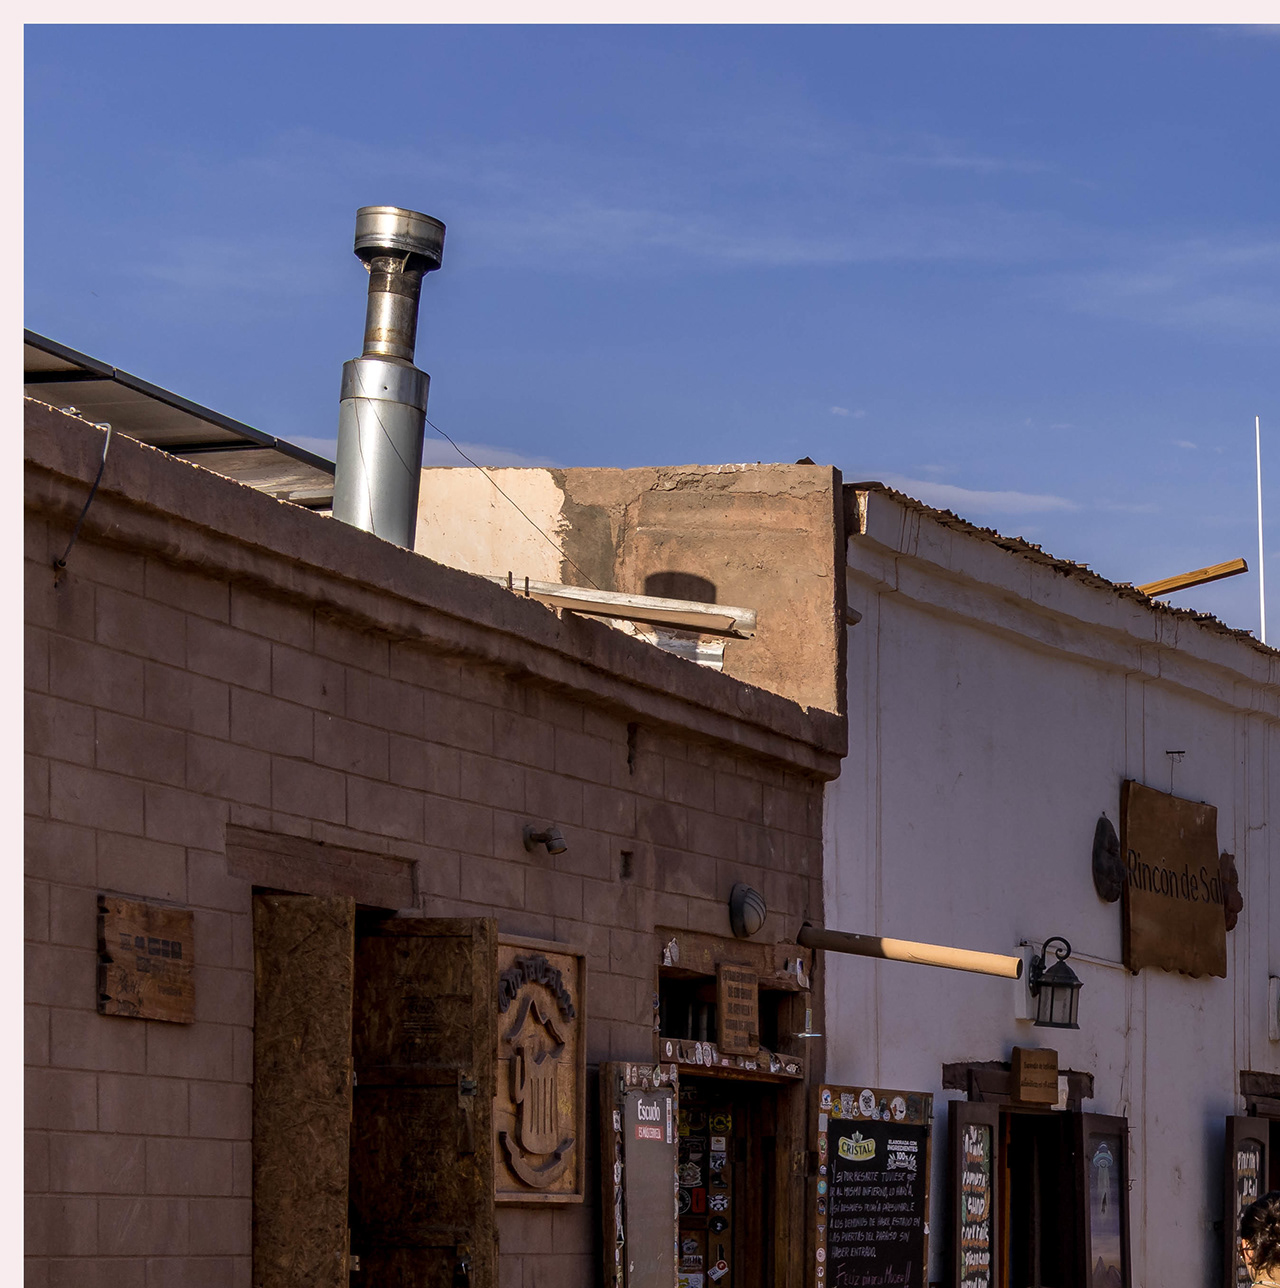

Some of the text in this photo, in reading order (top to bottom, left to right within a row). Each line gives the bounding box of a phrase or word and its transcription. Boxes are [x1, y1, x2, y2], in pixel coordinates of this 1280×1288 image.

[1127, 848, 1225, 907] Rincón de Sal
[637, 1098, 661, 1121] Escudo
[841, 1141, 873, 1156] CRISTAL
[836, 1262, 860, 1287] FELIZ
